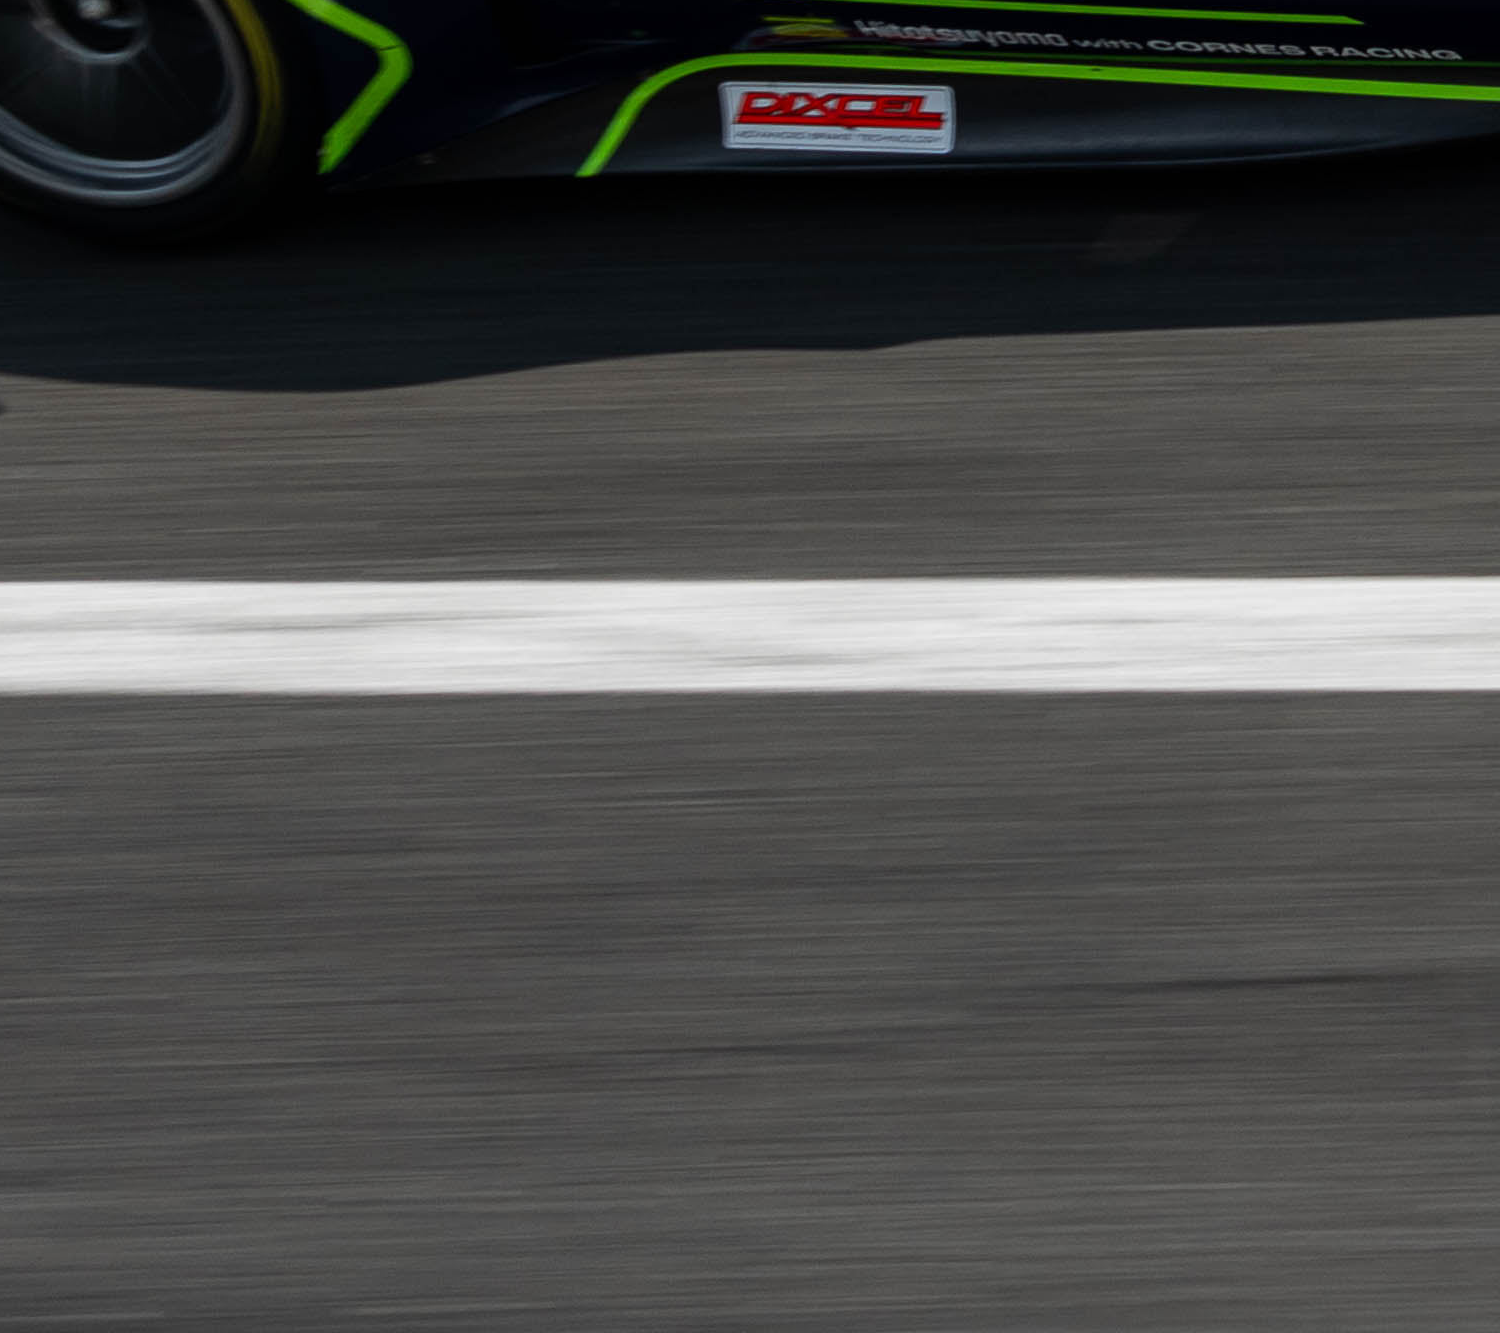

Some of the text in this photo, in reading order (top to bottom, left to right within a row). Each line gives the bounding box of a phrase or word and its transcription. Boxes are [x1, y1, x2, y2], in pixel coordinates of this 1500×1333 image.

[1074, 36, 1144, 51] with
[1146, 38, 1304, 58] CORNES
[1310, 45, 1464, 62] RACING
[735, 91, 946, 126] DIXCEL
